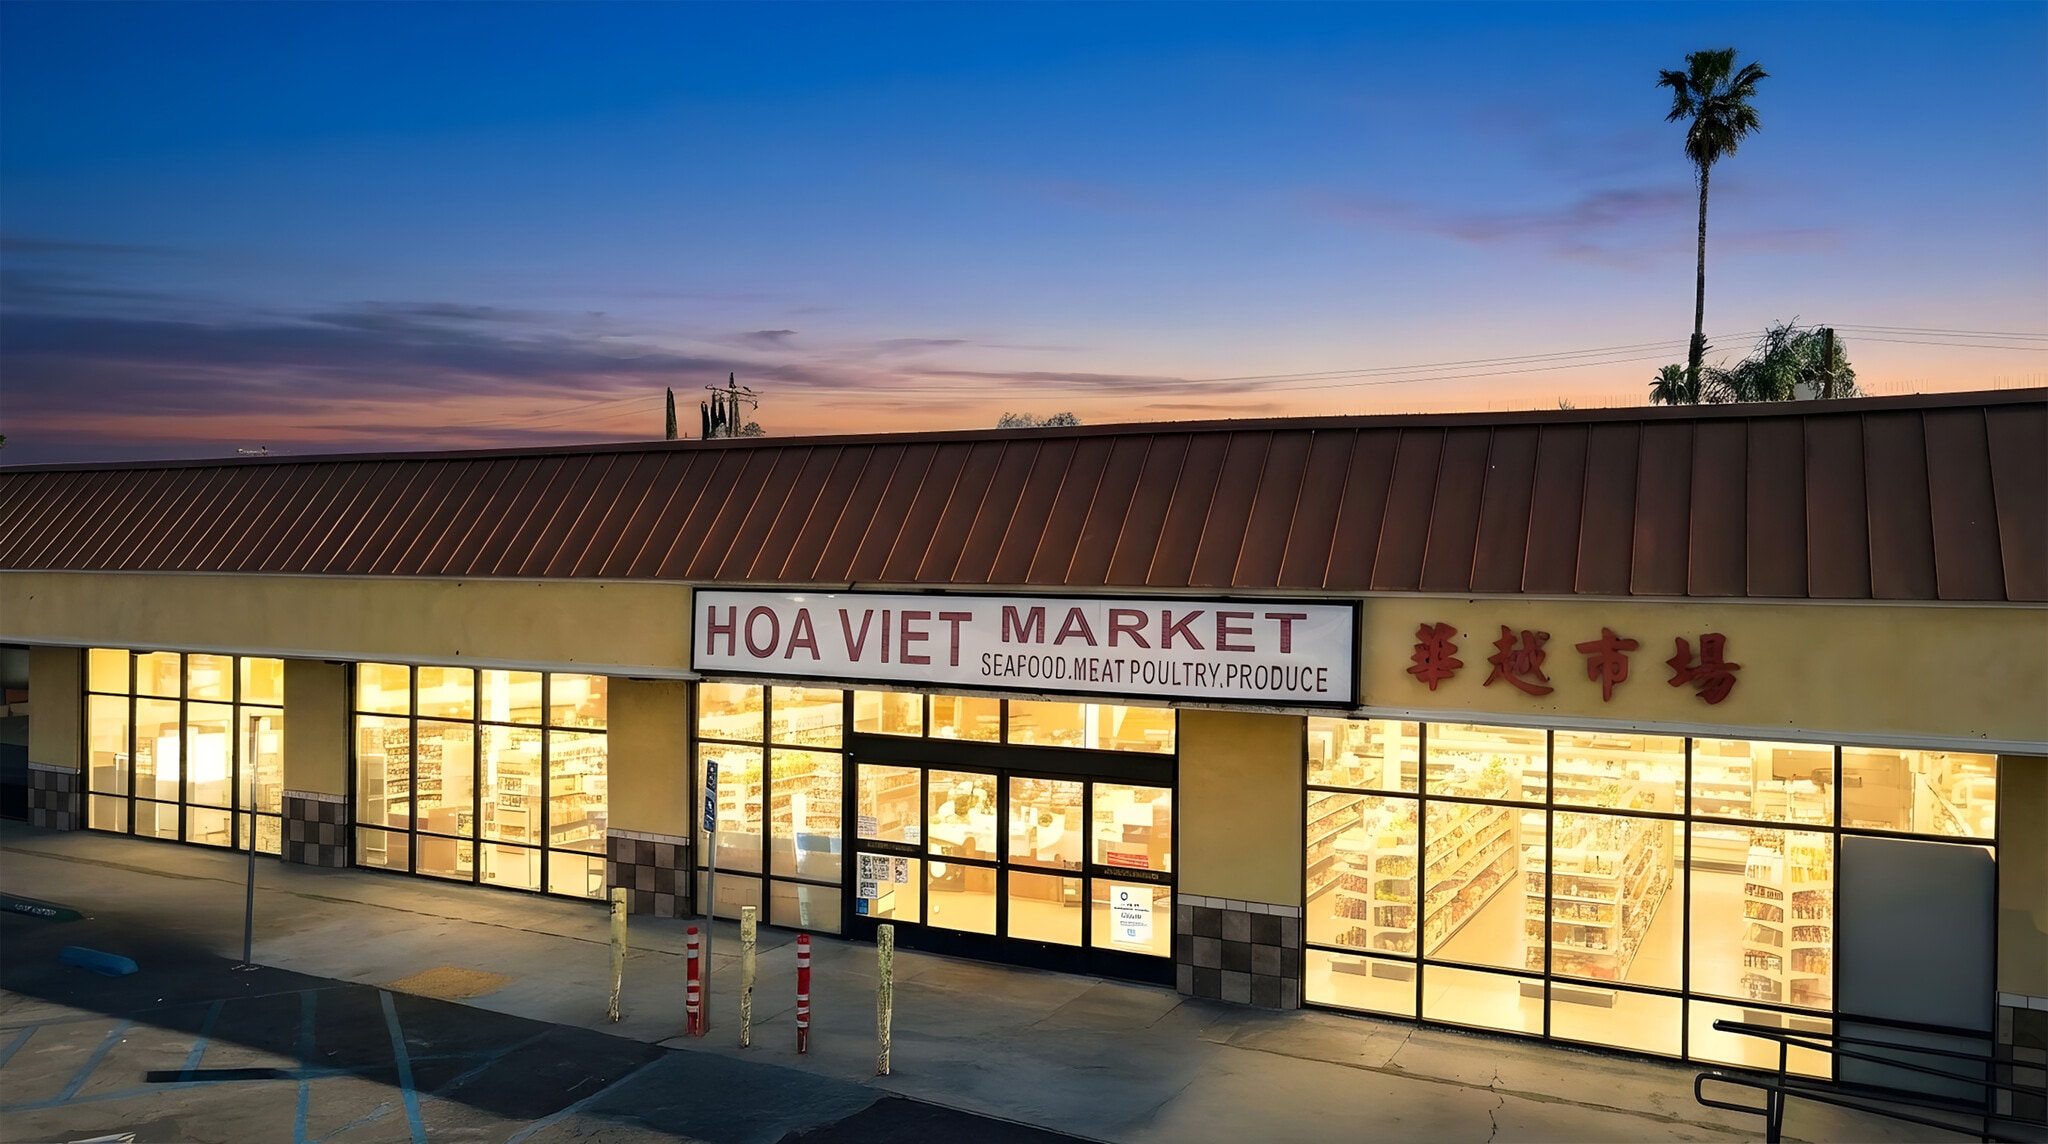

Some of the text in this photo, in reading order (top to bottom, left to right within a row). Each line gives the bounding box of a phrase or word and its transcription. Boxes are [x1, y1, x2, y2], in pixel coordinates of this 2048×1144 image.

[706, 605, 1307, 667] HOA VIET MARKET
[1406, 622, 1741, 705] 華越市場
